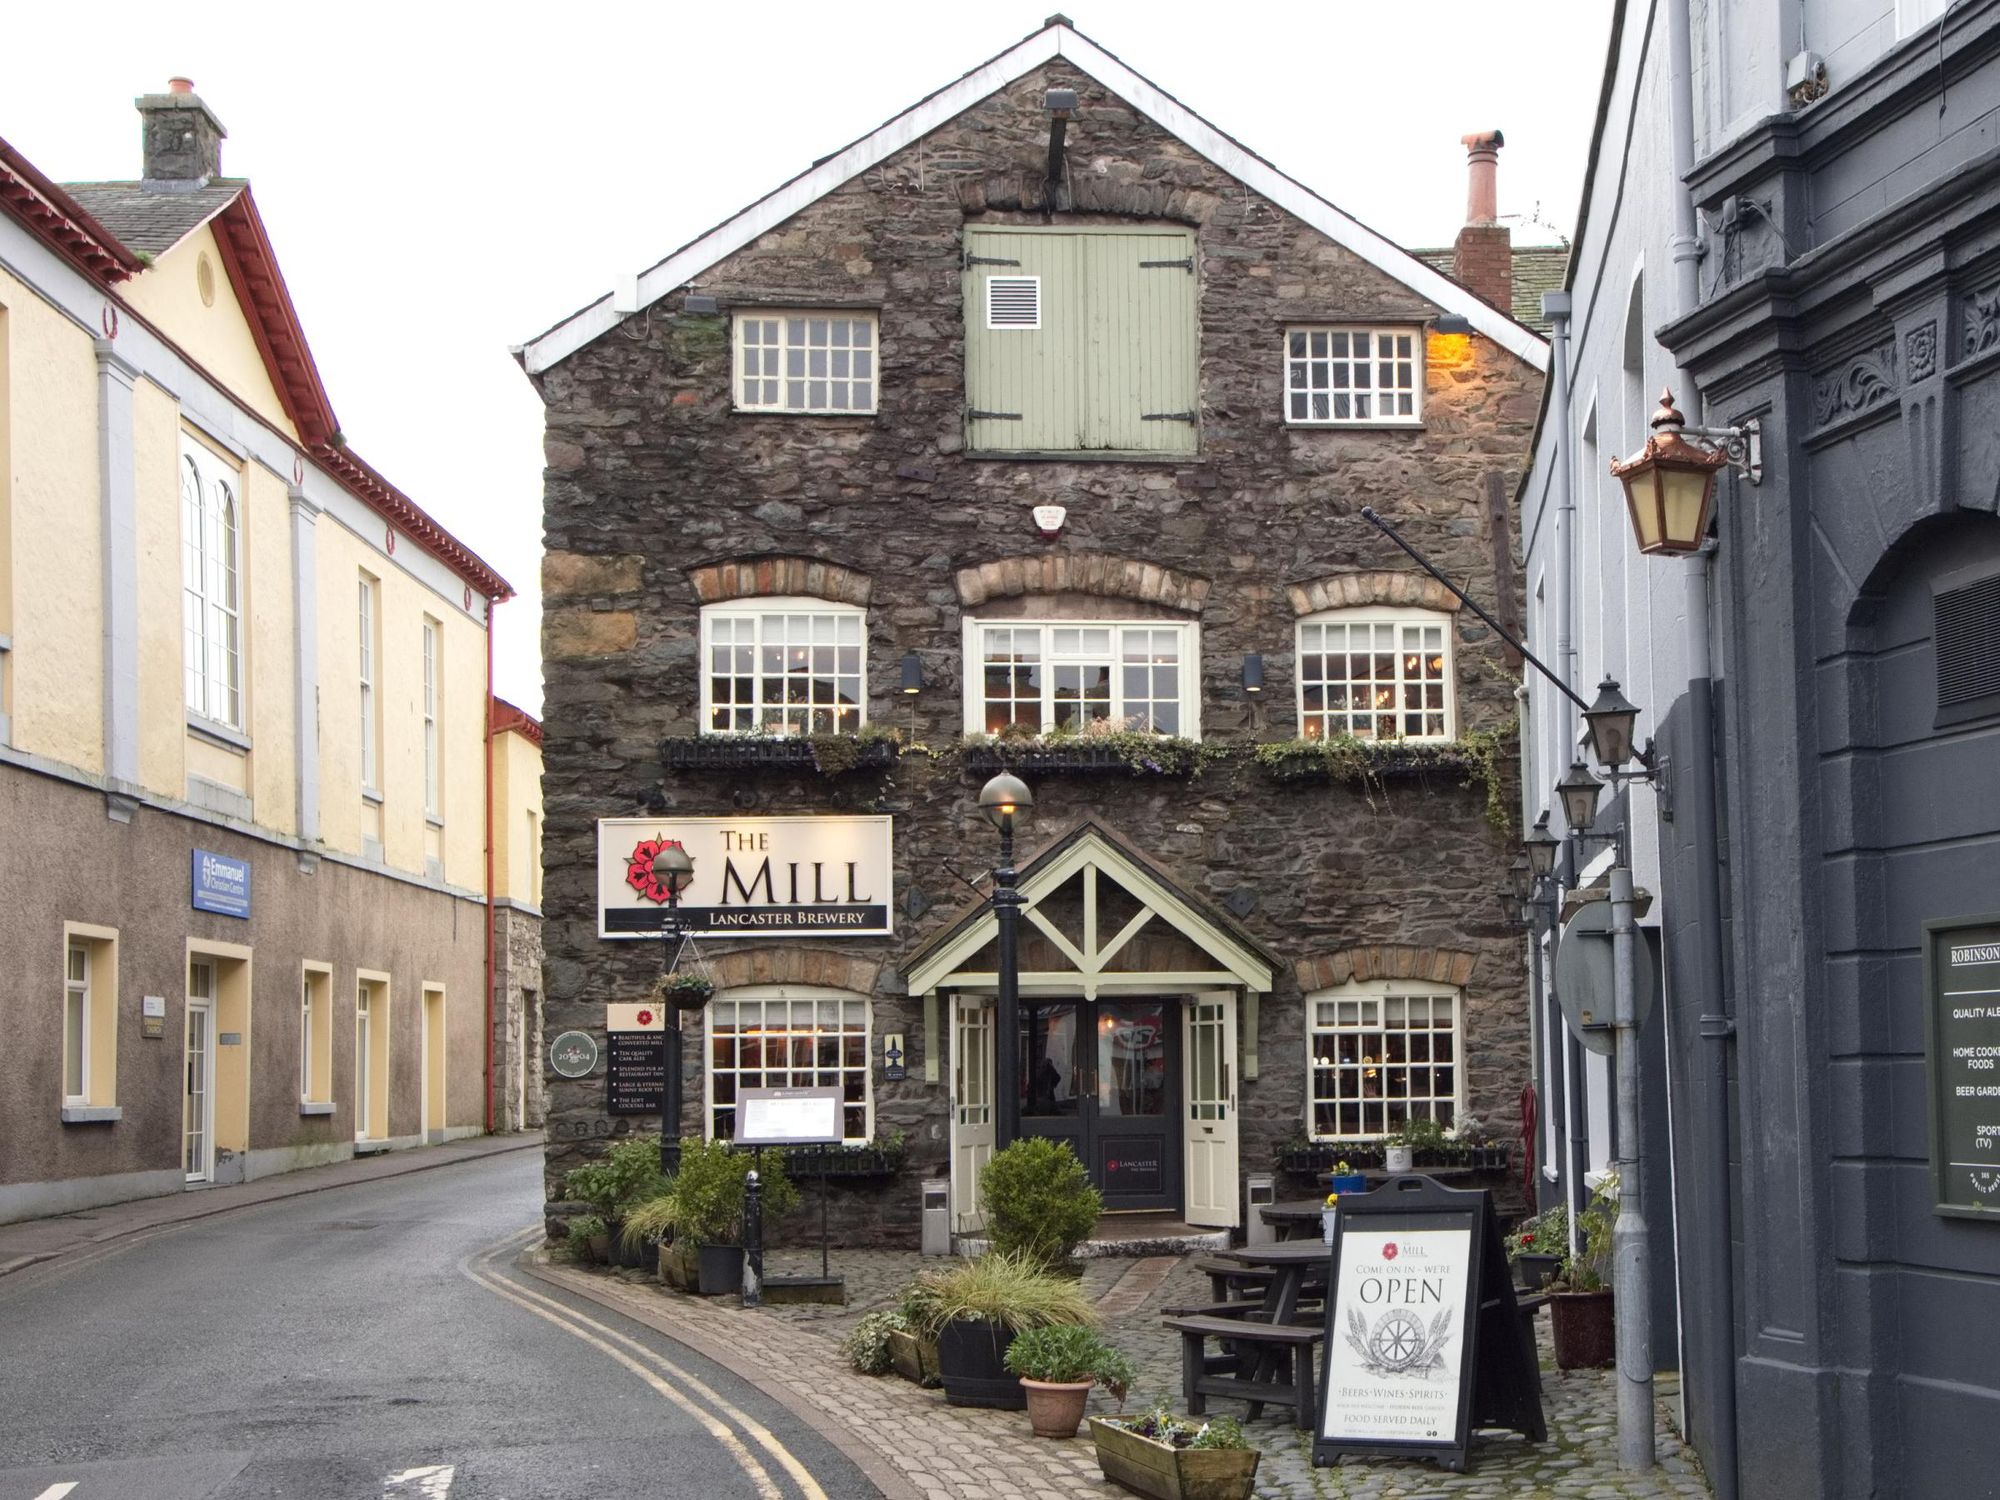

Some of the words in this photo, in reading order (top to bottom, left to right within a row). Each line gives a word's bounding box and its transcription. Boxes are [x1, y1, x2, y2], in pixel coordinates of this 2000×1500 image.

[720, 830, 769, 851] THE
[211, 857, 245, 883] Emmanuel
[718, 855, 872, 905] MILL
[709, 913, 793, 926] LANCASTER
[797, 911, 865, 925] BREWERY
[1952, 1007, 1985, 1019] QUALITY
[1953, 1047, 1975, 1057] HOME
[1967, 1059, 1995, 1069] FOODS
[1956, 1086, 1975, 1096] BEER
[1975, 1138, 1992, 1149] (TV)
[1120, 1160, 1158, 1168] LANCASTER
[1355, 1264, 1383, 1274] COME
[1386, 1265, 1401, 1274] ON
[1404, 1265, 1416, 1274] IN
[1360, 1278, 1443, 1304] OPEN
[1344, 1414, 1371, 1424] FOOD
[1373, 1415, 1407, 1425] SERVED
[1409, 1415, 1437, 1426] DAILY
